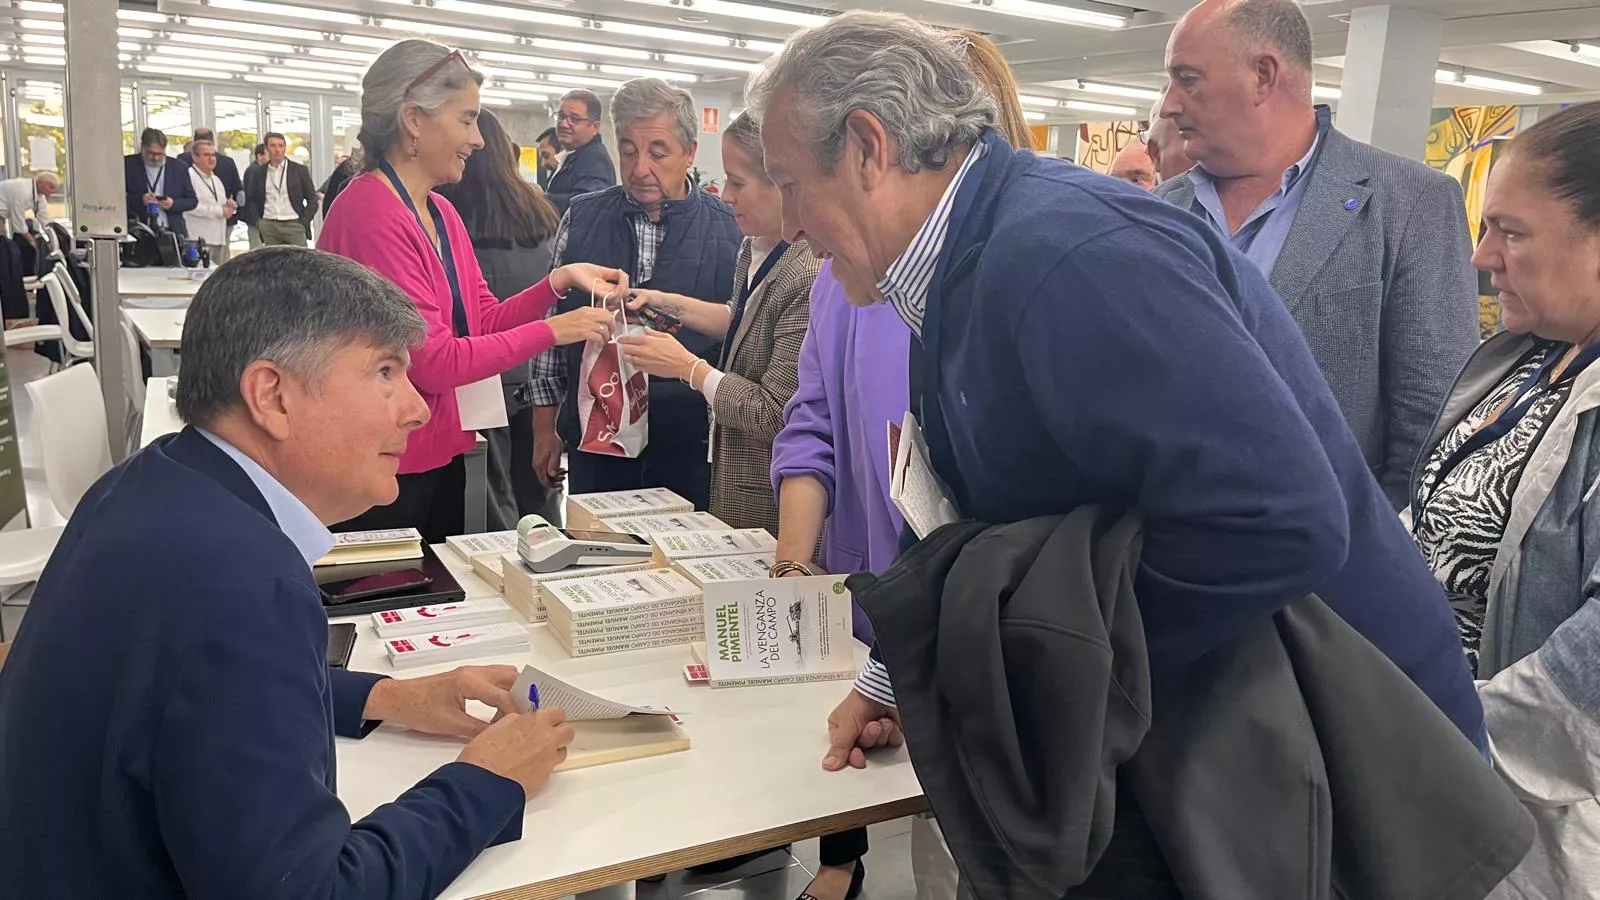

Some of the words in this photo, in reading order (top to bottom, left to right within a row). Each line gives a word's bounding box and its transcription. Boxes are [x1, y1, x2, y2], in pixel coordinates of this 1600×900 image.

[576, 620, 603, 628] PIMENTEL
[716, 604, 730, 661] MANUEL
[728, 601, 742, 663] PIMENTEL
[755, 589, 768, 654] VENGANZA
[766, 597, 778, 641] CAMPO
[760, 656, 770, 668] LA
[769, 642, 780, 661] DEL
